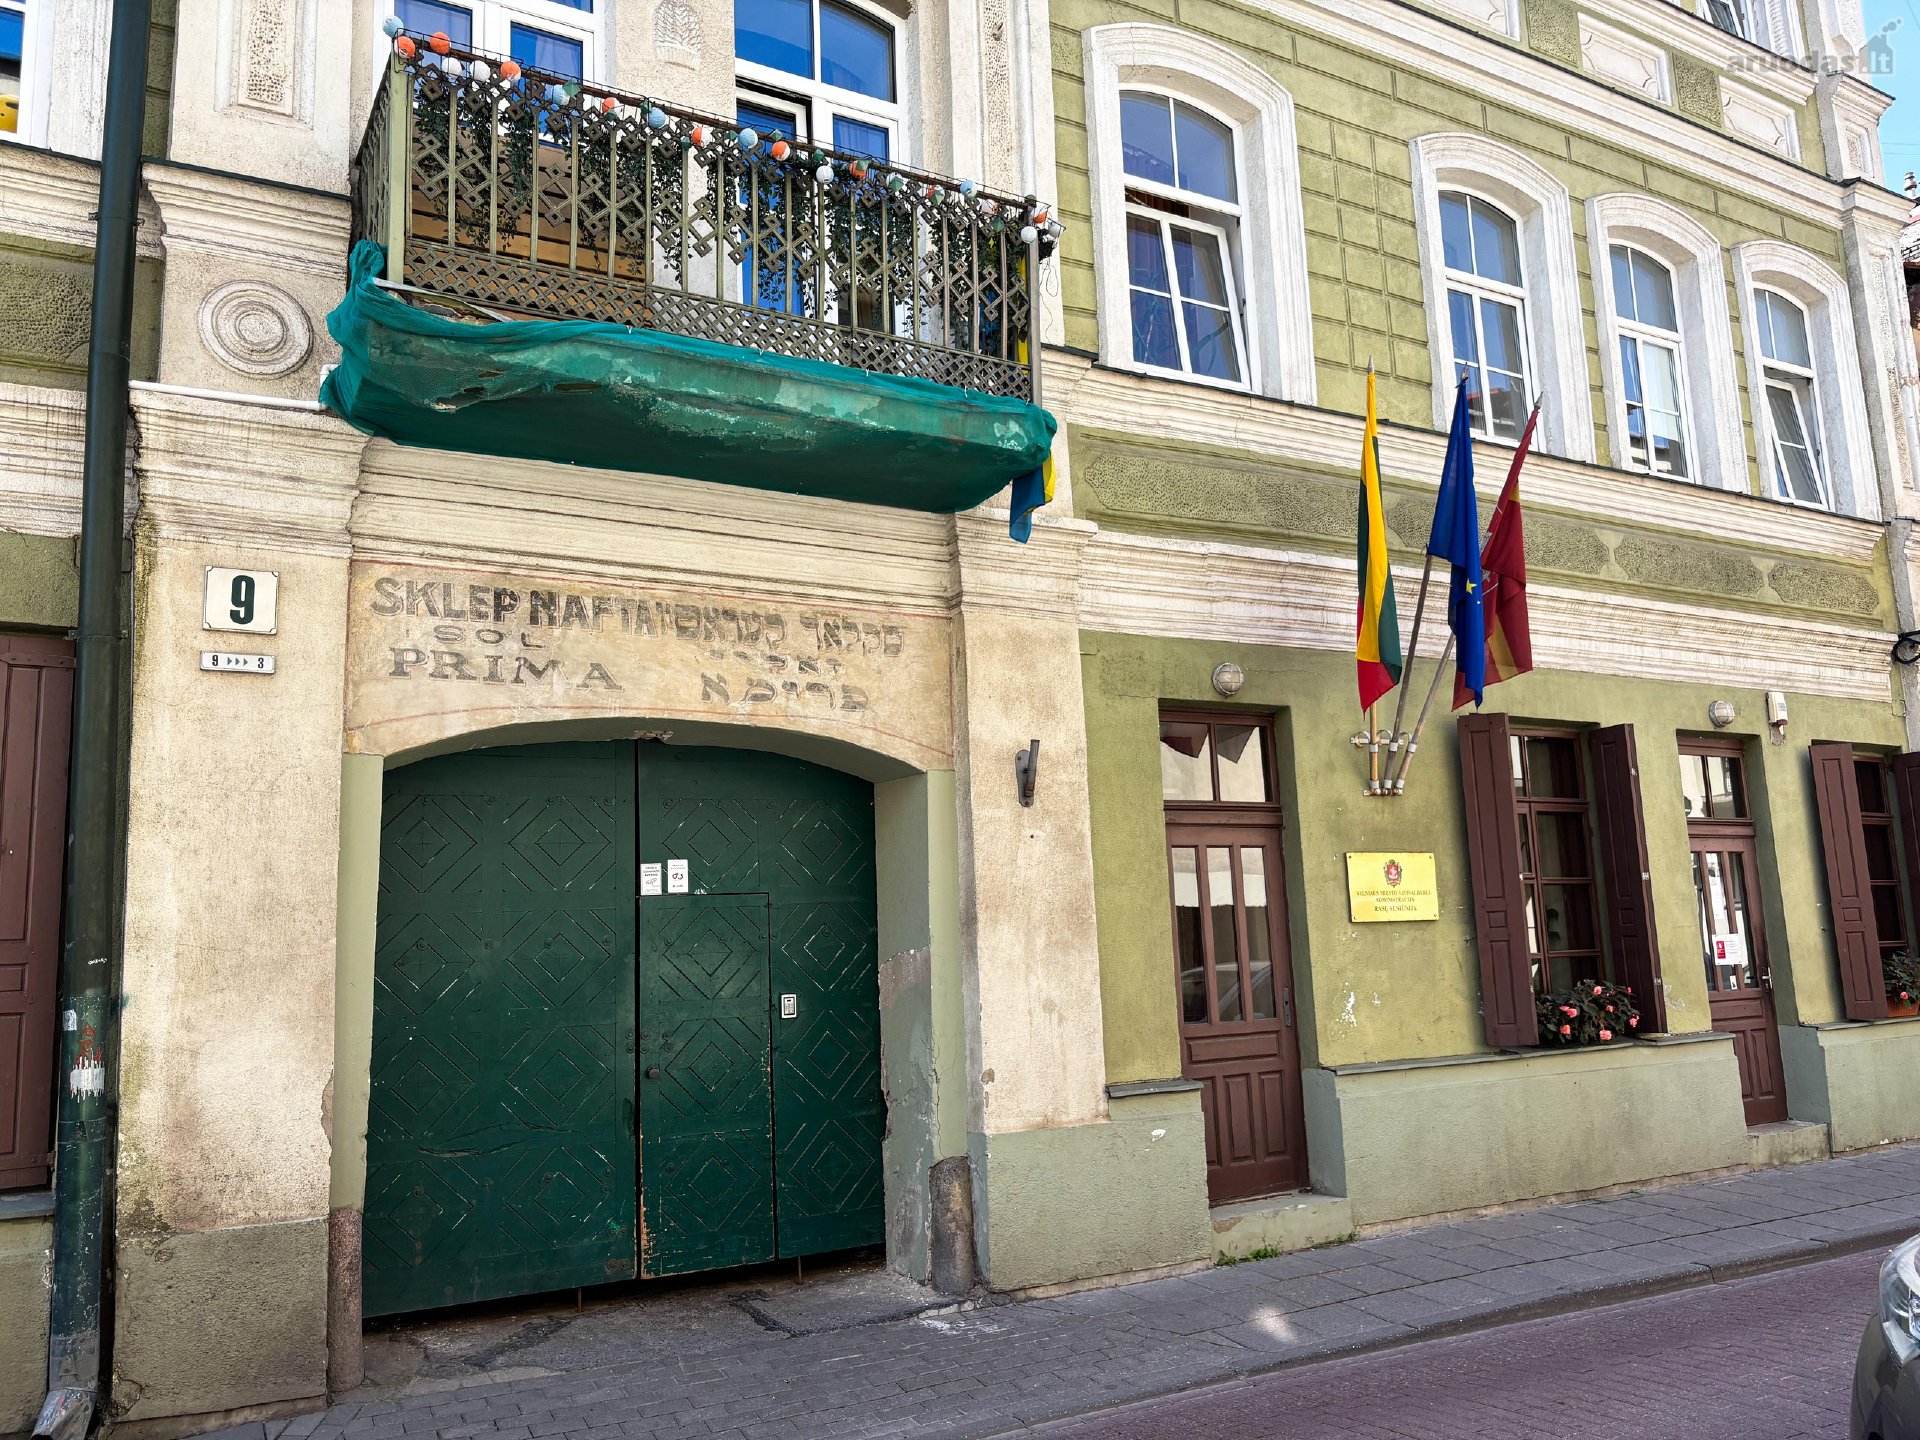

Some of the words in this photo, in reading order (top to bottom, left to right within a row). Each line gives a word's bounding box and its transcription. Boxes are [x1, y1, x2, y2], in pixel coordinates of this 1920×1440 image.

[230, 575, 255, 625] 9
[370, 577, 521, 623] SKLEP
[529, 589, 658, 637] NAFTA
[432, 624, 548, 650] SOL
[212, 655, 219, 667] 9
[258, 658, 264, 669] 3
[388, 646, 625, 692] PRIMA
